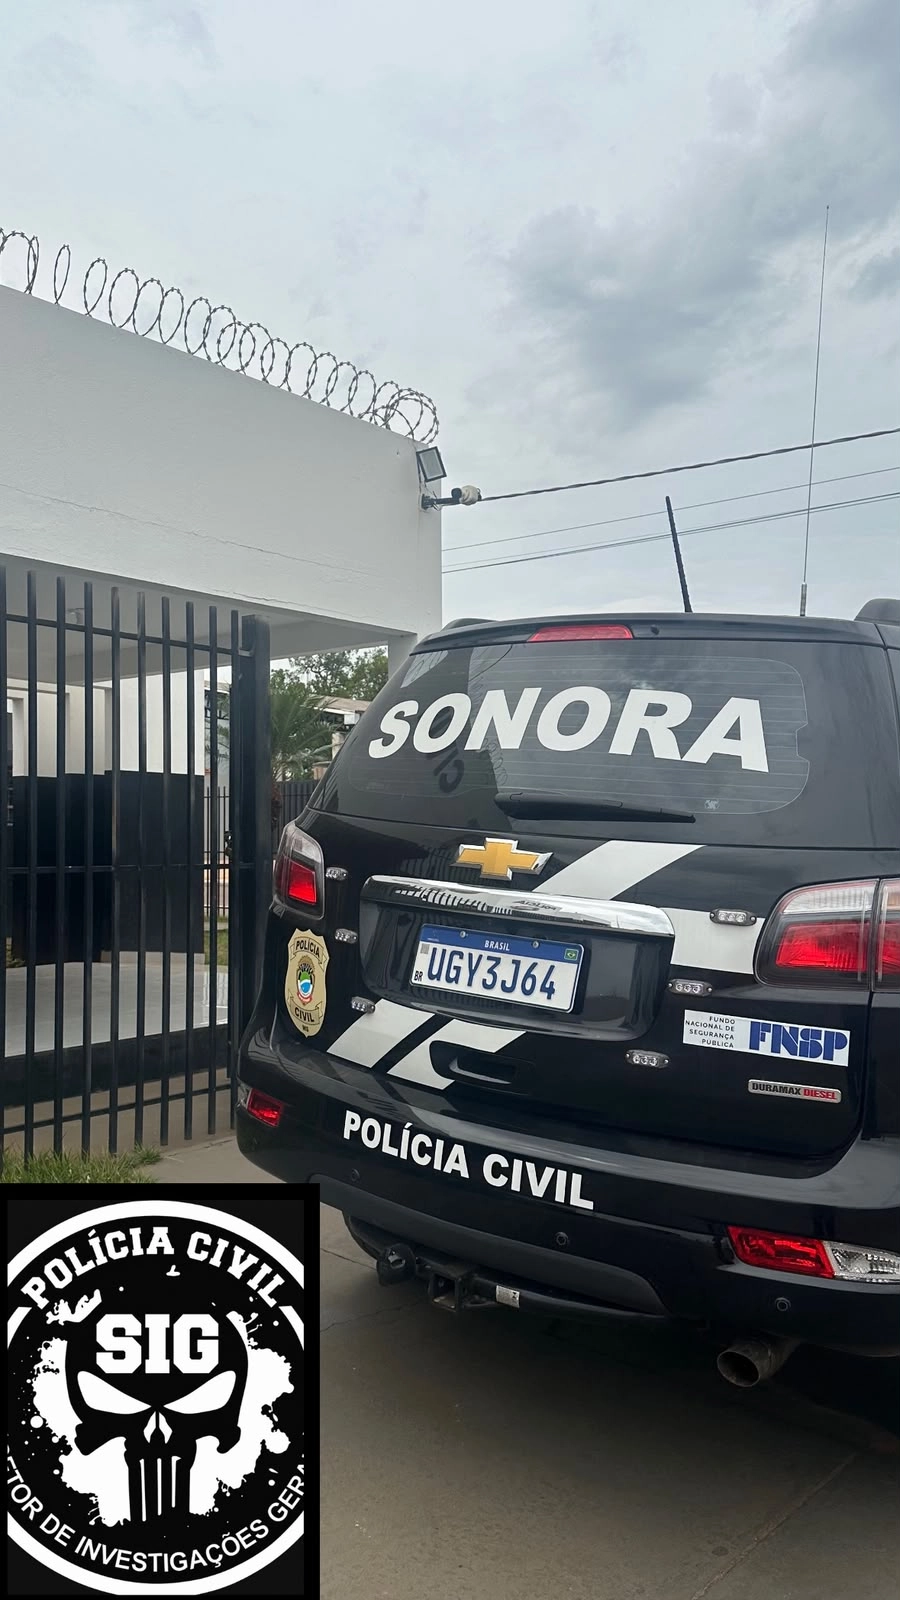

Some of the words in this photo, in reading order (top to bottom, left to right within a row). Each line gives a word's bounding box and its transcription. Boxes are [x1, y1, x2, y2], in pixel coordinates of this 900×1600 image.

[368, 685, 769, 773] SONORA
[484, 940, 510, 951] BRASIL
[413, 970, 424, 982] BR
[427, 947, 556, 1000] UGY3J64
[294, 1007, 315, 1022] CIVIL
[709, 1016, 735, 1025] FUNDO
[685, 1020, 723, 1030] NACIONAL
[689, 1029, 734, 1040] SEGURANÇA
[749, 1021, 848, 1061] FNSP
[752, 1082, 801, 1096] DURAMAX
[803, 1088, 837, 1100] DIESEL
[343, 1110, 469, 1179] POLÍCIA
[482, 1153, 594, 1210] CIVIL
